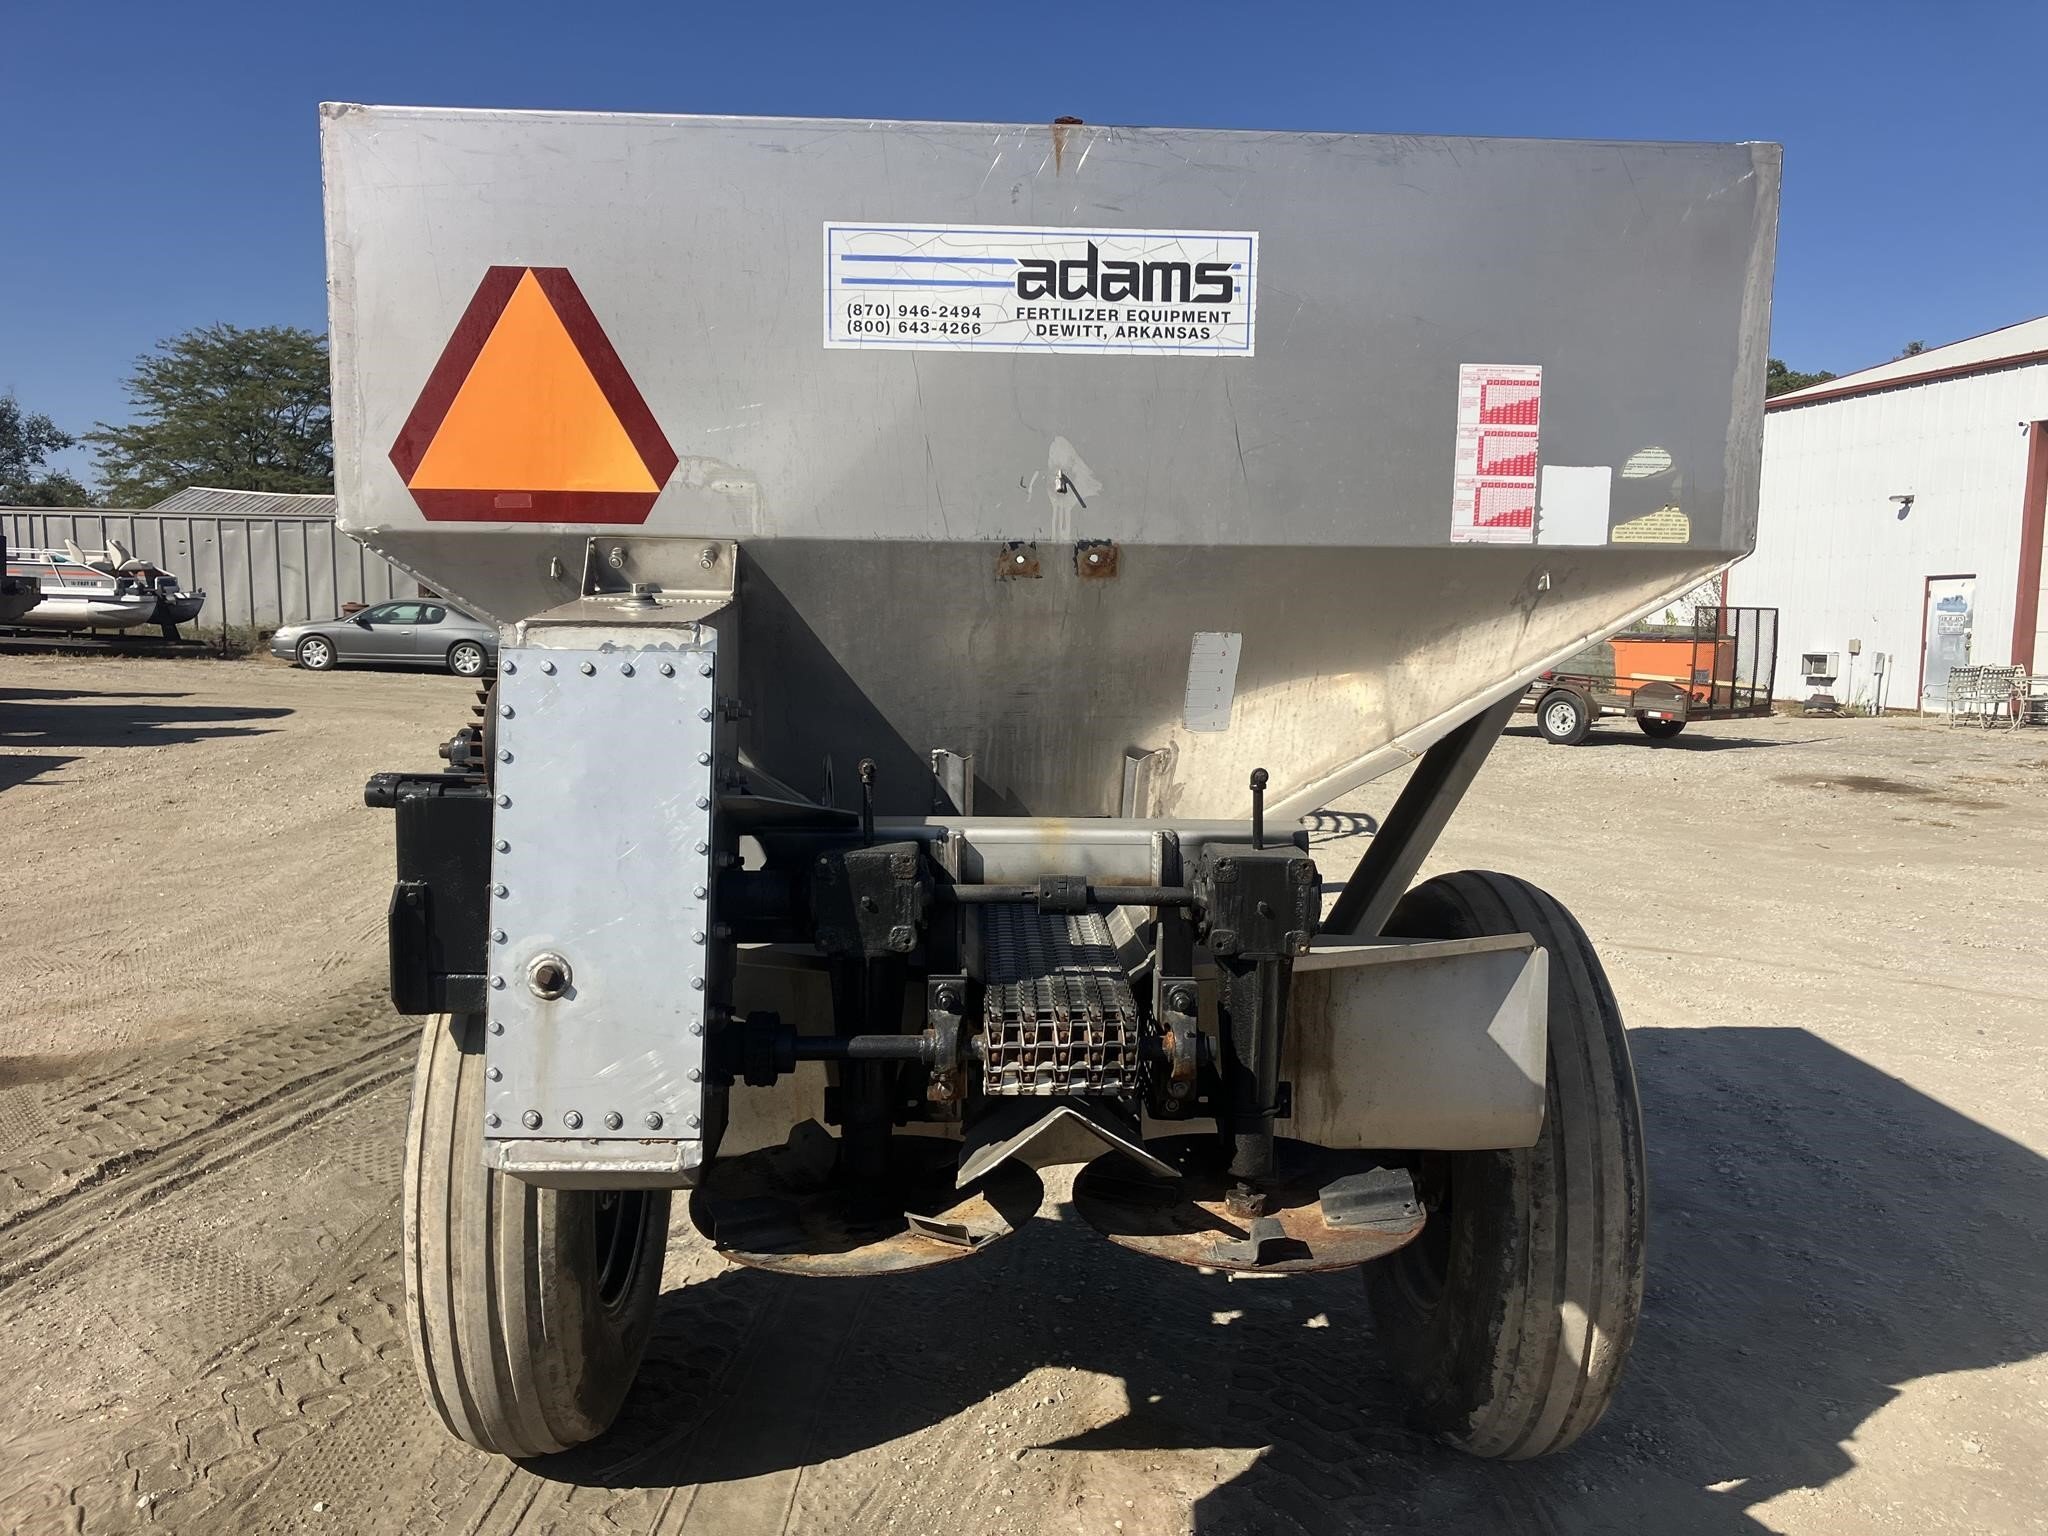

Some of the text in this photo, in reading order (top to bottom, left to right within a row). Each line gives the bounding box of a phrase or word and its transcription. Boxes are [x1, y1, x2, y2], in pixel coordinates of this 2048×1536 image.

[1017, 239, 1234, 304] adams
[847, 303, 982, 319] (870) 946-2494
[1016, 307, 1231, 324] FERTILIZER EQUIPMENT
[847, 319, 982, 335] (800) 643-4266
[1036, 324, 1210, 340] DEWITT, ARKANSAS
